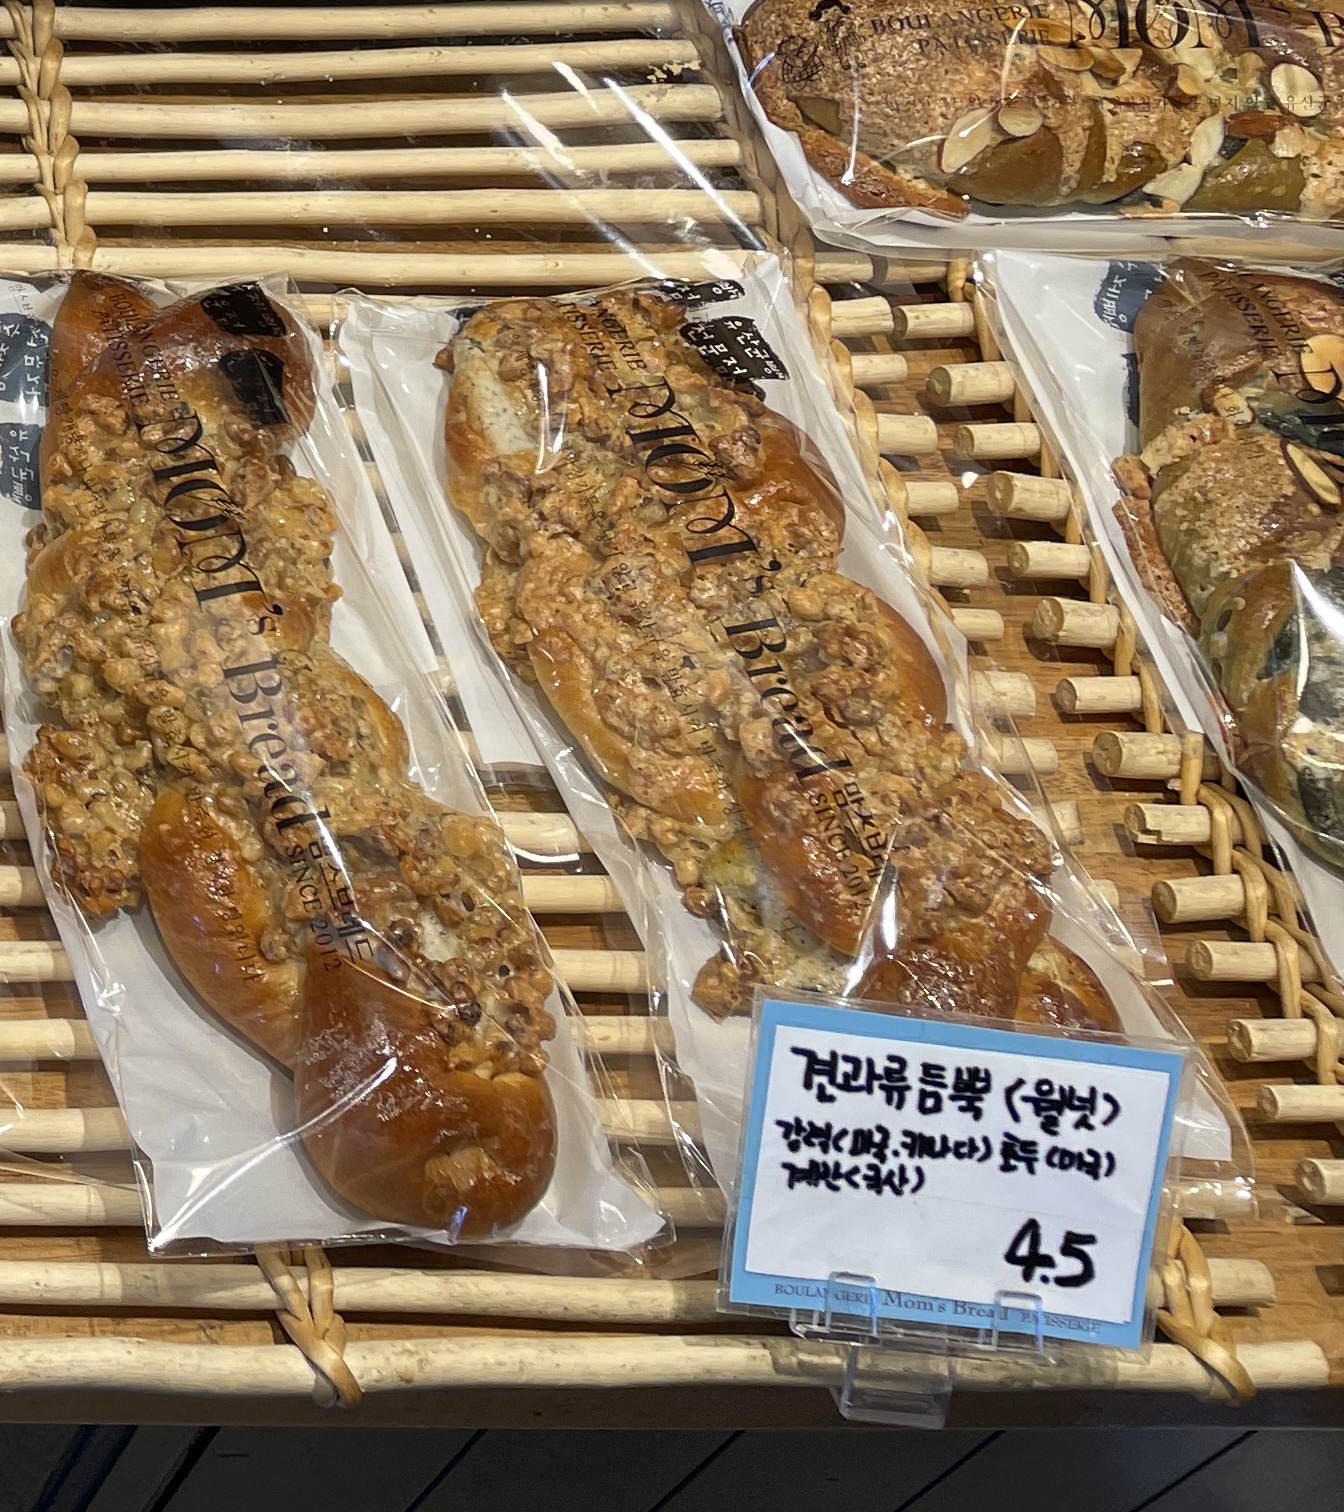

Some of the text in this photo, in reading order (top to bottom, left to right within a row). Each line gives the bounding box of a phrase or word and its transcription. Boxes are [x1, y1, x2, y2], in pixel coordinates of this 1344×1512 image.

[562, 301, 618, 372] TISSERIE
[617, 376, 781, 596] MOM's
[726, 613, 853, 784] Bread
[133, 408, 284, 636] MOM's
[223, 656, 331, 838] Bread
[806, 791, 849, 856] SINCE
[285, 844, 343, 972] SINCE 2012
[1004, 1218, 1097, 1288] 4.5
[885, 1290, 946, 1313] Mom's
